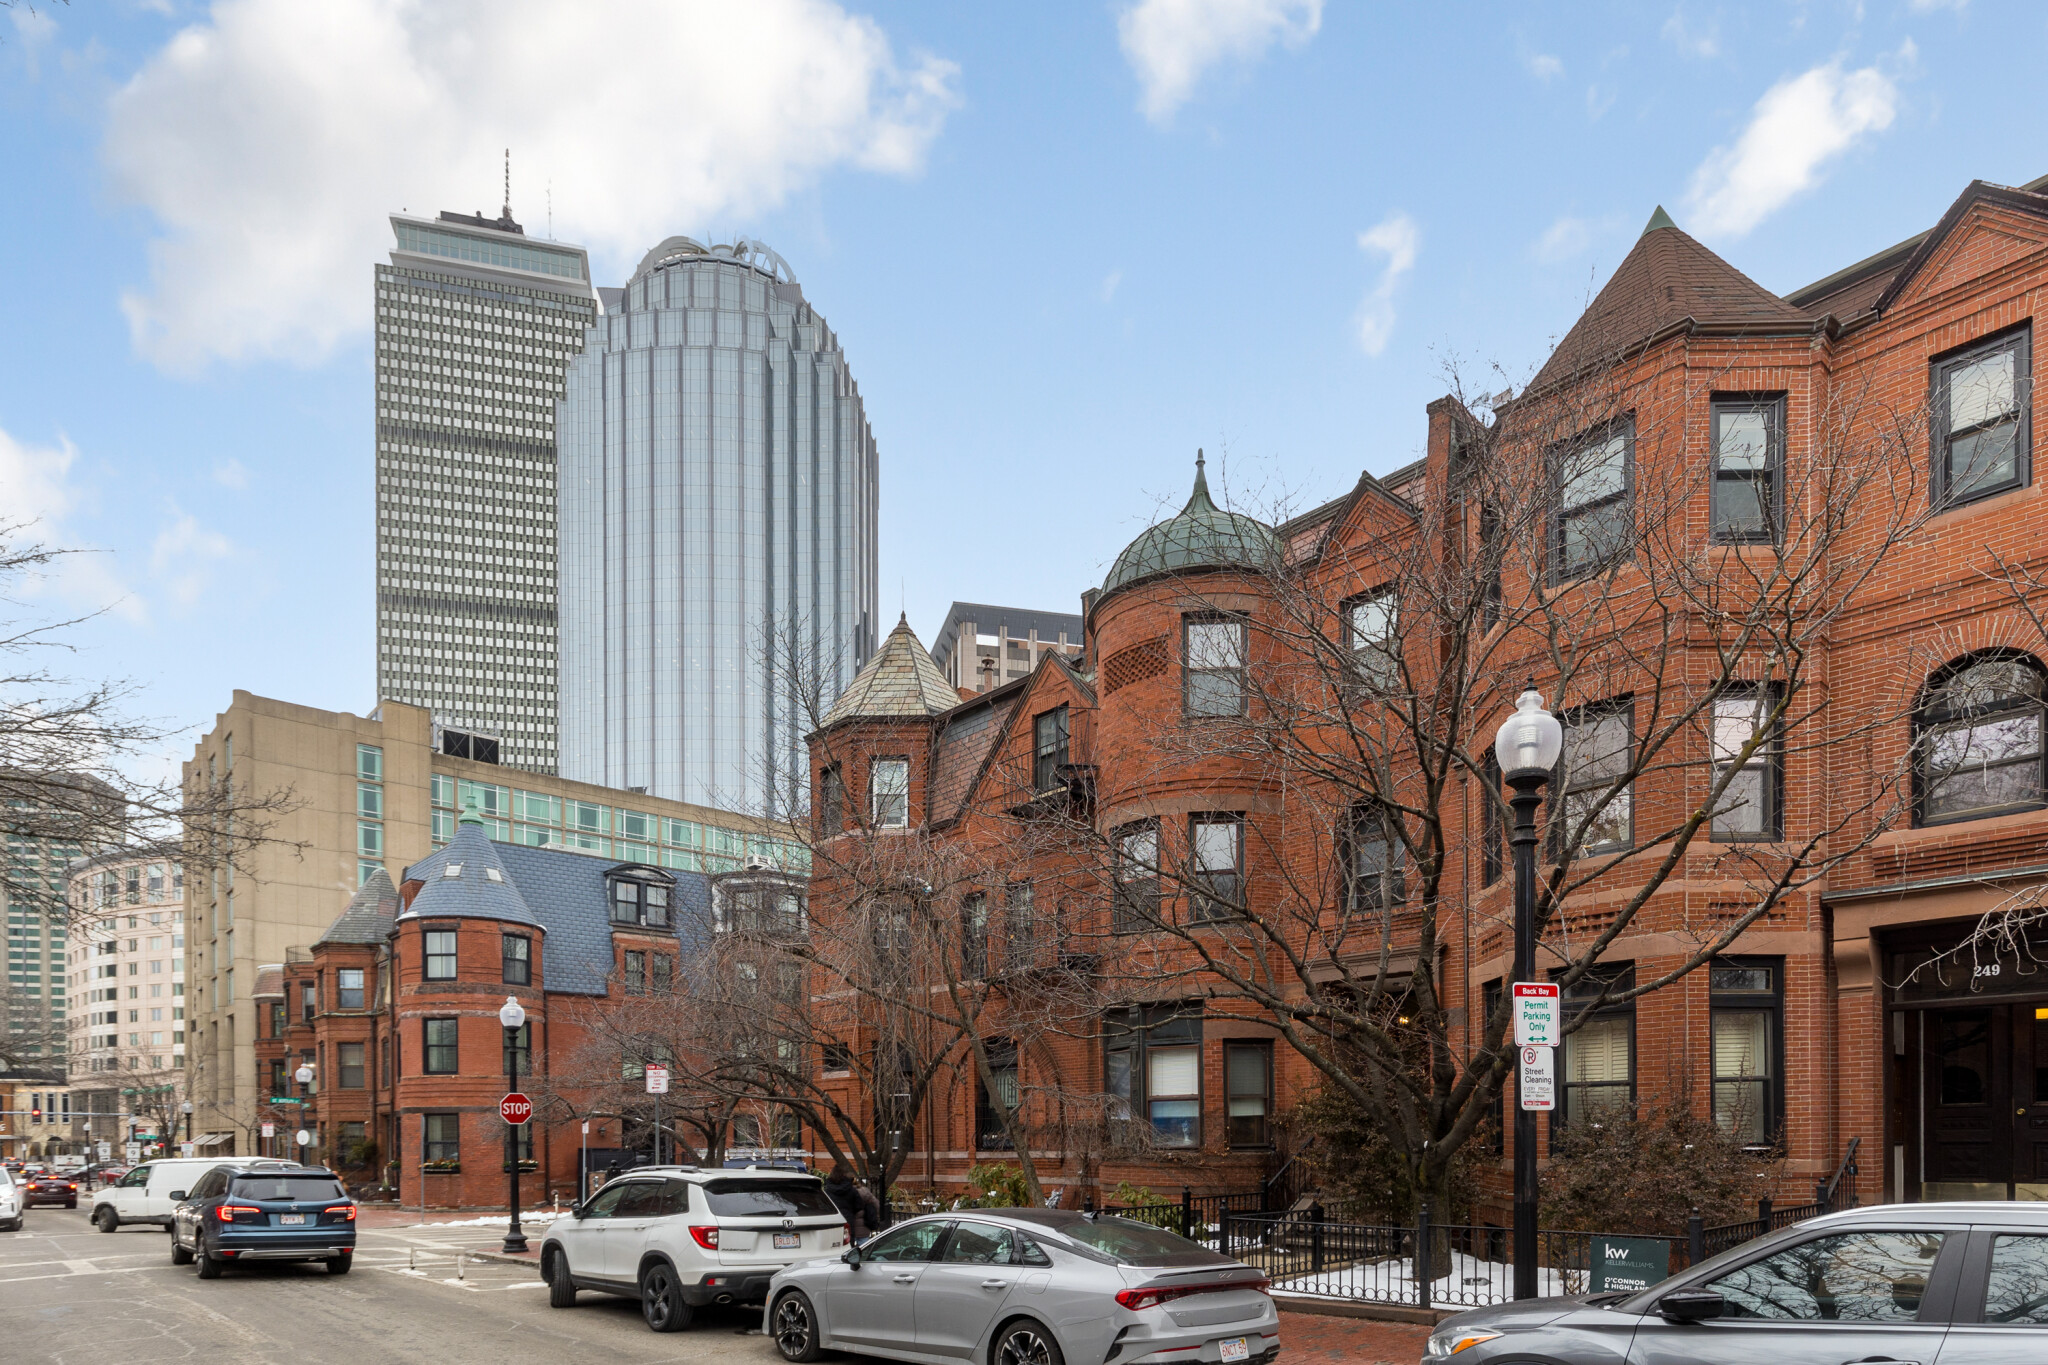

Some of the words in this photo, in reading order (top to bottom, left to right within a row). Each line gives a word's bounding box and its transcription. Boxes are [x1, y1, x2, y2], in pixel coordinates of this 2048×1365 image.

[1974, 964, 2000, 977] 249
[1522, 987, 1537, 995] Back
[1538, 988, 1550, 996] Bay
[1524, 1000, 1548, 1009] Permit
[1523, 1011, 1551, 1022] Parking
[1529, 1022, 1546, 1032] Only
[1524, 1067, 1545, 1075] Street
[1524, 1075, 1552, 1085] Cleaning
[502, 1102, 530, 1115] STOP
[1605, 1243, 1629, 1259] kw
[1604, 1276, 1646, 1287] O'CONNOR
